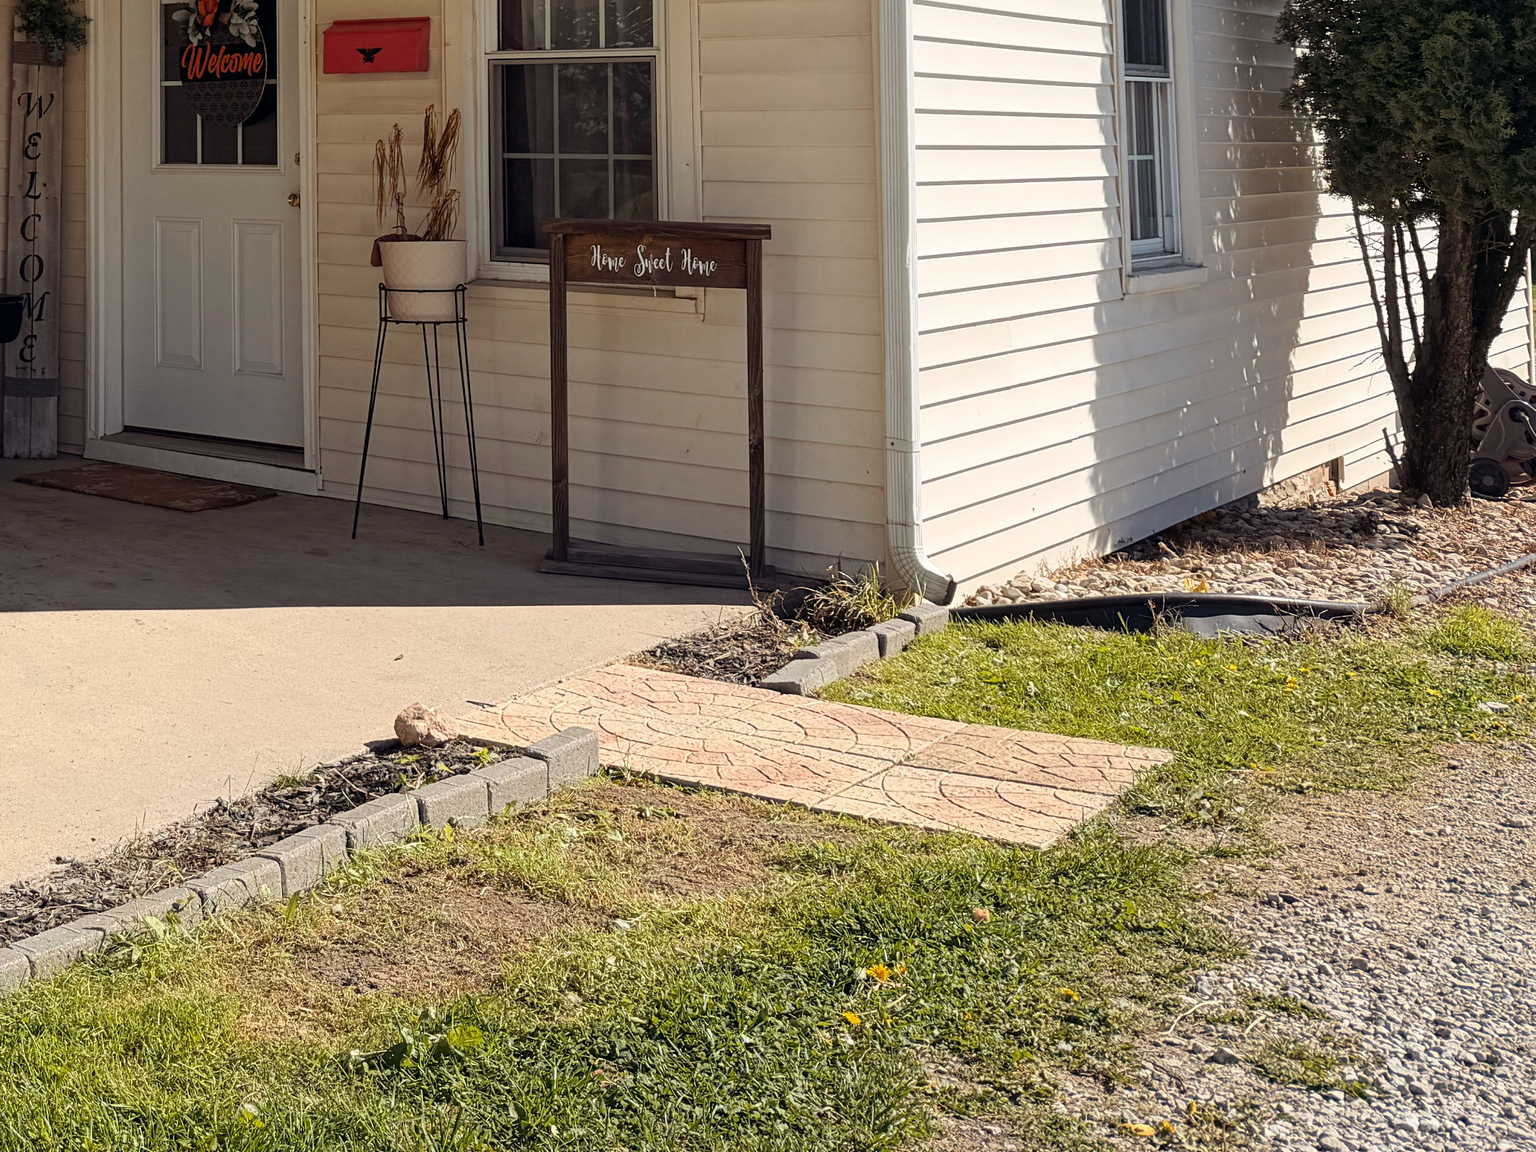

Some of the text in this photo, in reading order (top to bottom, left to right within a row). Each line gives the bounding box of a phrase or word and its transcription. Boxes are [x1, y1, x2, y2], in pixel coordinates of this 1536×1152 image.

[181, 41, 264, 80] Welcome
[17, 92, 55, 363] WELCOME
[590, 244, 718, 277] Home Sweet Home
